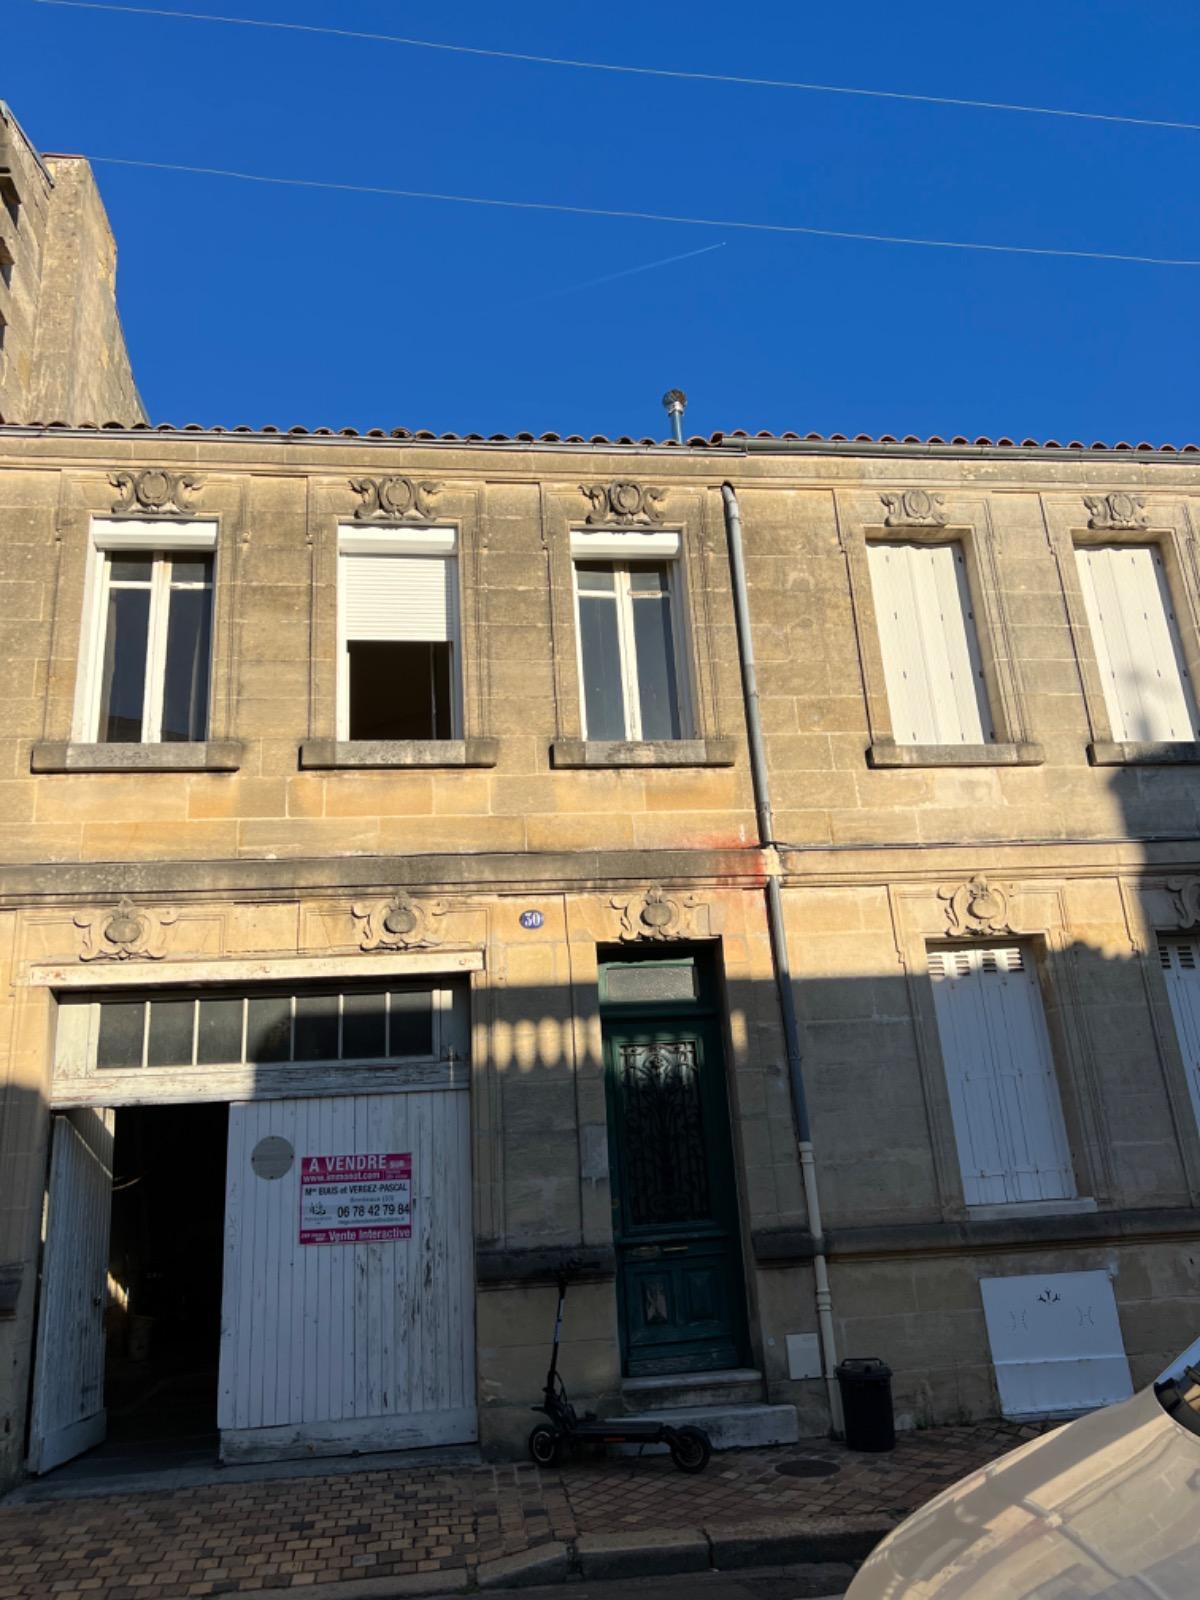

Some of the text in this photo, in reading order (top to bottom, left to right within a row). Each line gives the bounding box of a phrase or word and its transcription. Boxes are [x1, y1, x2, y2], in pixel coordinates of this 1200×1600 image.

[309, 1155, 388, 1172] A VENDRE
[340, 1185, 348, 1194] et
[337, 1206, 350, 1219] 06
[367, 1204, 380, 1217] 42
[383, 1203, 396, 1216] 79
[398, 1203, 410, 1216] 84
[328, 1231, 356, 1241] Vente
